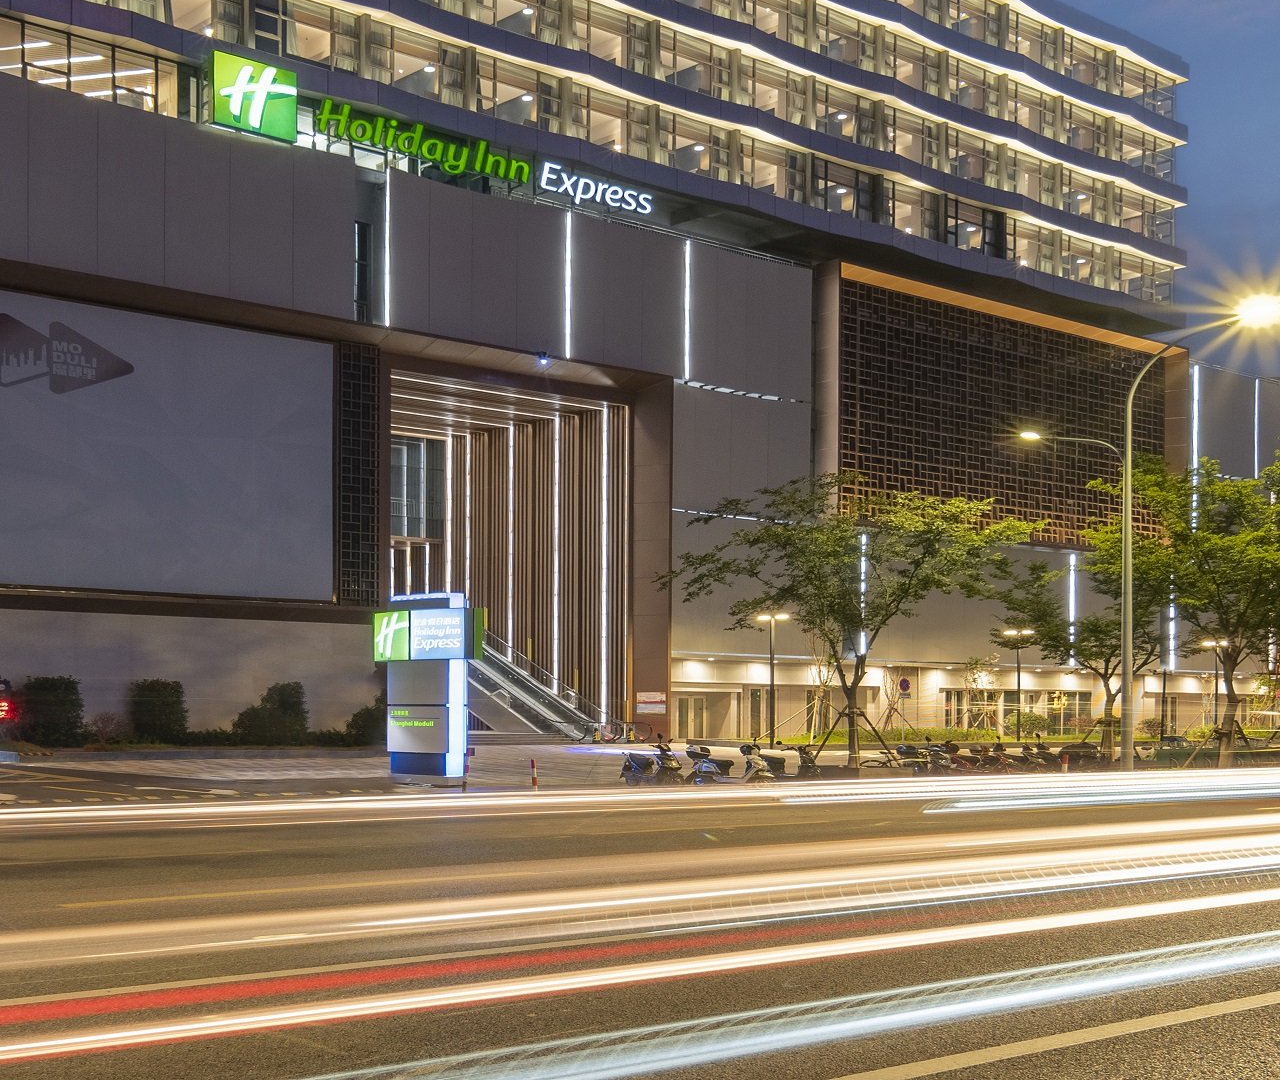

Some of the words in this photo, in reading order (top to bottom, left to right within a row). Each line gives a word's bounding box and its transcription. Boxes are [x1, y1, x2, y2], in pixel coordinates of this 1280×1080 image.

[316, 98, 471, 175] Holiday
[474, 139, 531, 185] Inn
[539, 161, 654, 216] Express
[52, 340, 82, 354] MO
[52, 351, 97, 368] DULI
[414, 626, 445, 637] Holiday
[446, 625, 461, 635] Inn
[414, 636, 462, 651] Express
